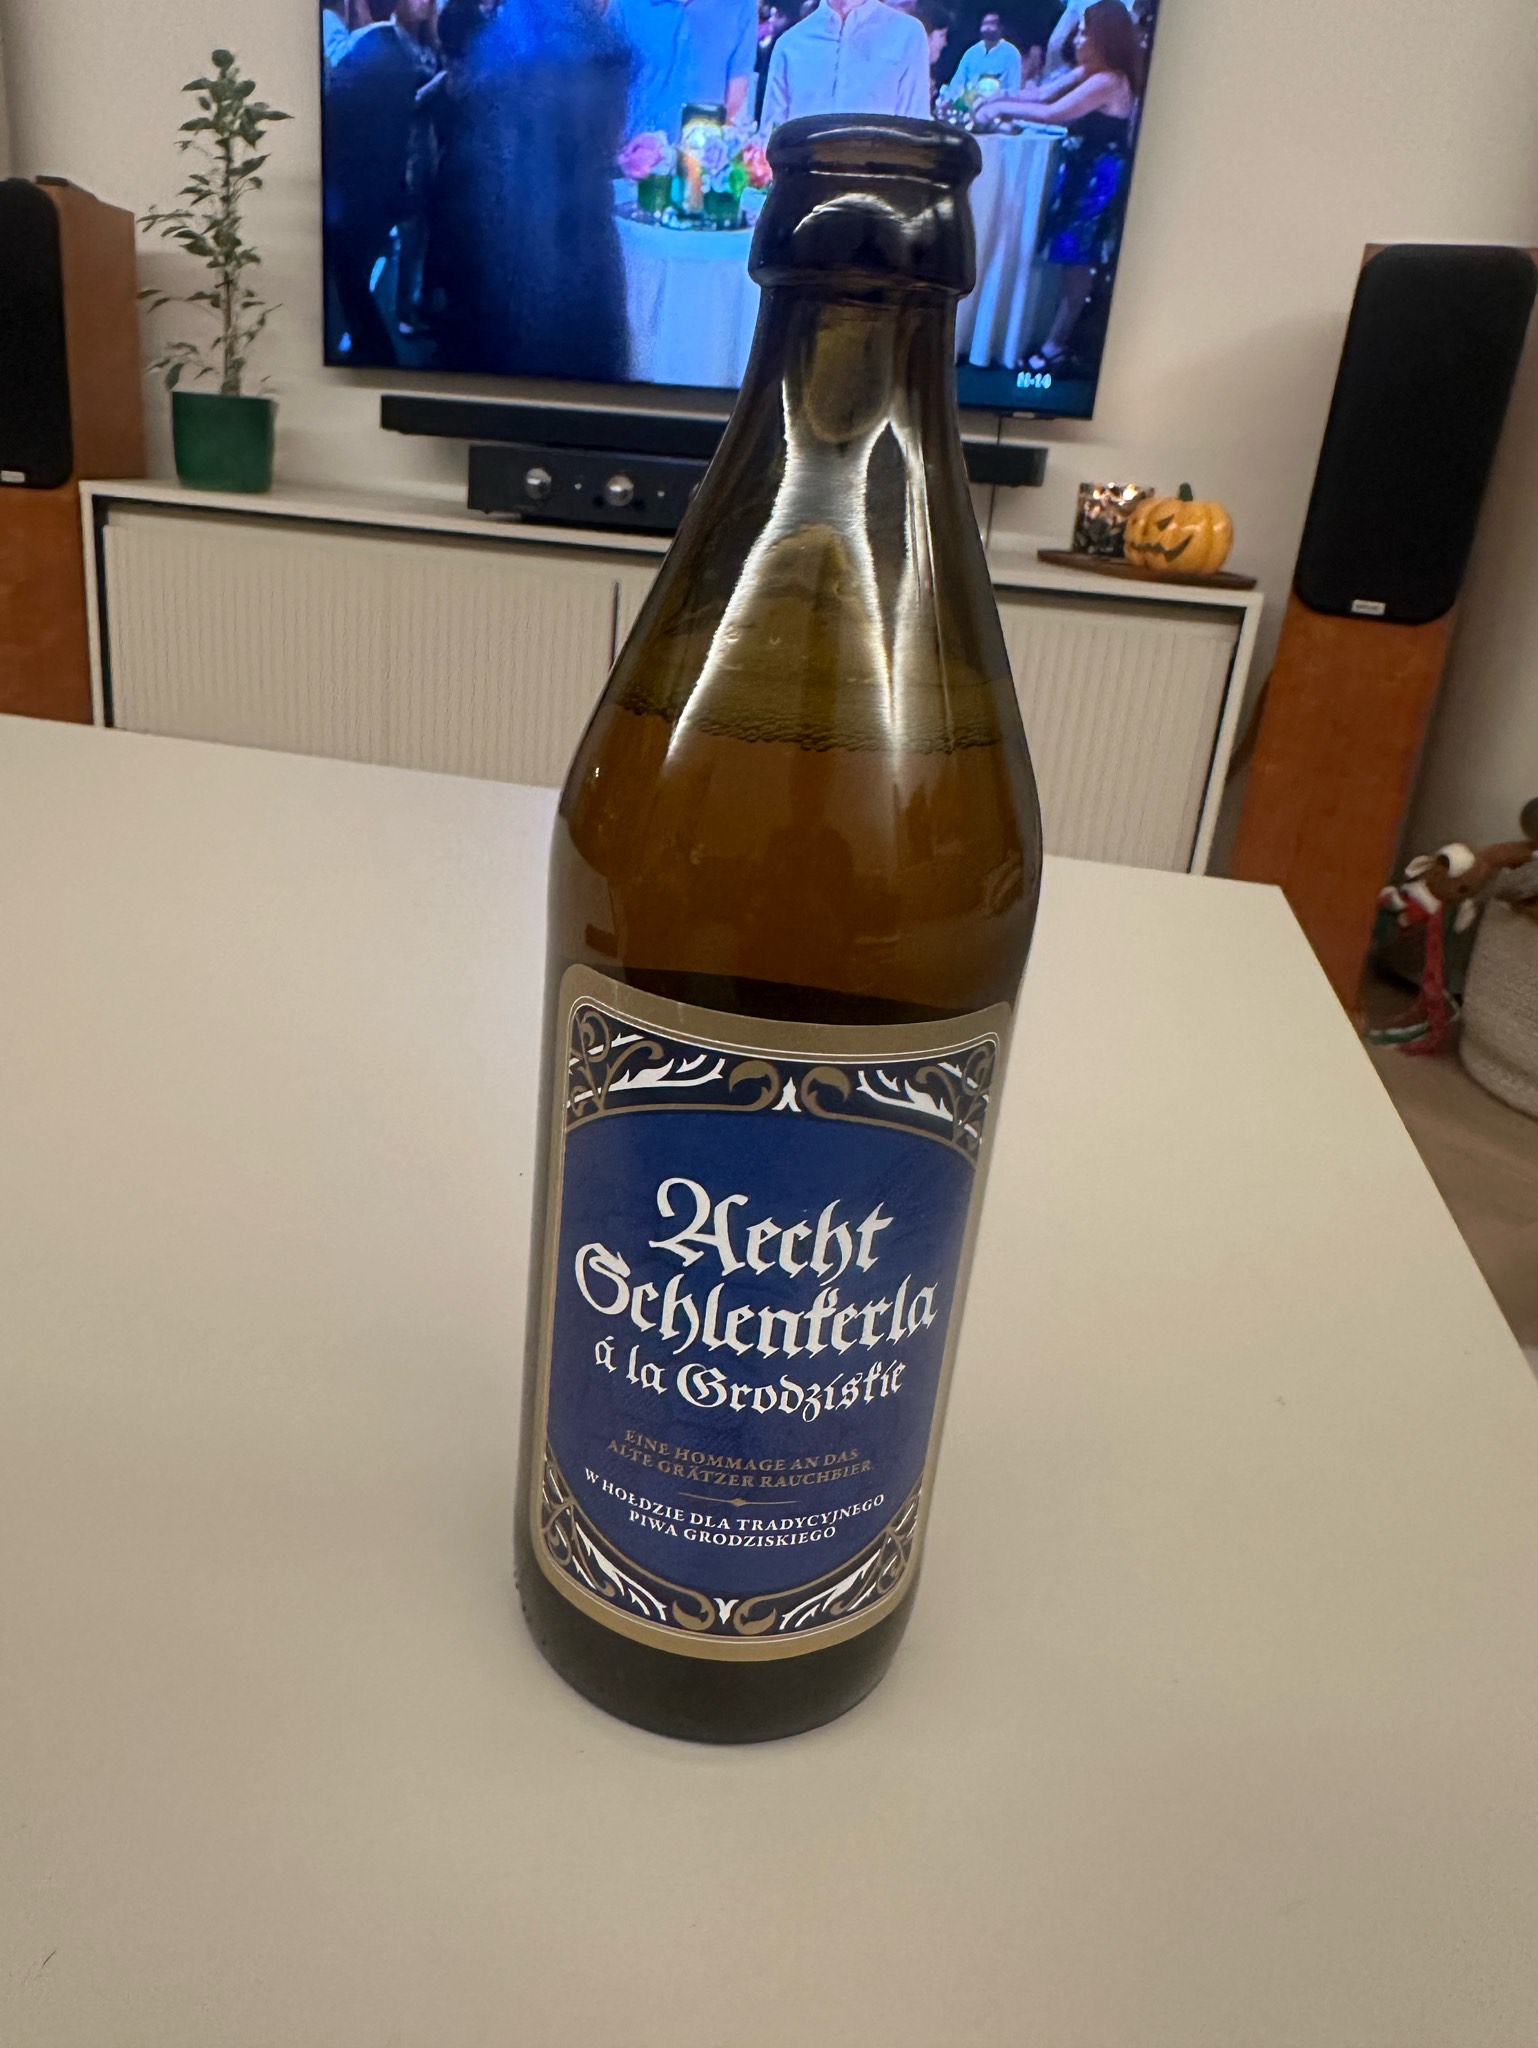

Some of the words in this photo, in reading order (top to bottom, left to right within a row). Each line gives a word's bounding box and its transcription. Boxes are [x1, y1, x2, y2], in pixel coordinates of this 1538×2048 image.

[648, 1177, 895, 1287] Aecht
[575, 1242, 939, 1359] Schlenkerla
[626, 1345, 667, 1395] la
[676, 1360, 906, 1423] Grodziskie
[607, 1439, 653, 1467] ALTE
[656, 1460, 755, 1488] GRÄTZER
[760, 1459, 873, 1489] RAUCHBIER
[624, 1429, 669, 1457] EINE
[673, 1446, 785, 1471] HOMMAGE
[789, 1454, 820, 1471] AN
[823, 1448, 860, 1467] DAS
[584, 1467, 599, 1485] W
[602, 1479, 686, 1523] HOŁDZIE
[689, 1511, 731, 1531] DLA
[736, 1494, 886, 1532] TRADYCYJNEGO
[629, 1509, 679, 1538] PIWA
[683, 1526, 836, 1548] GRODZISKIEGO
